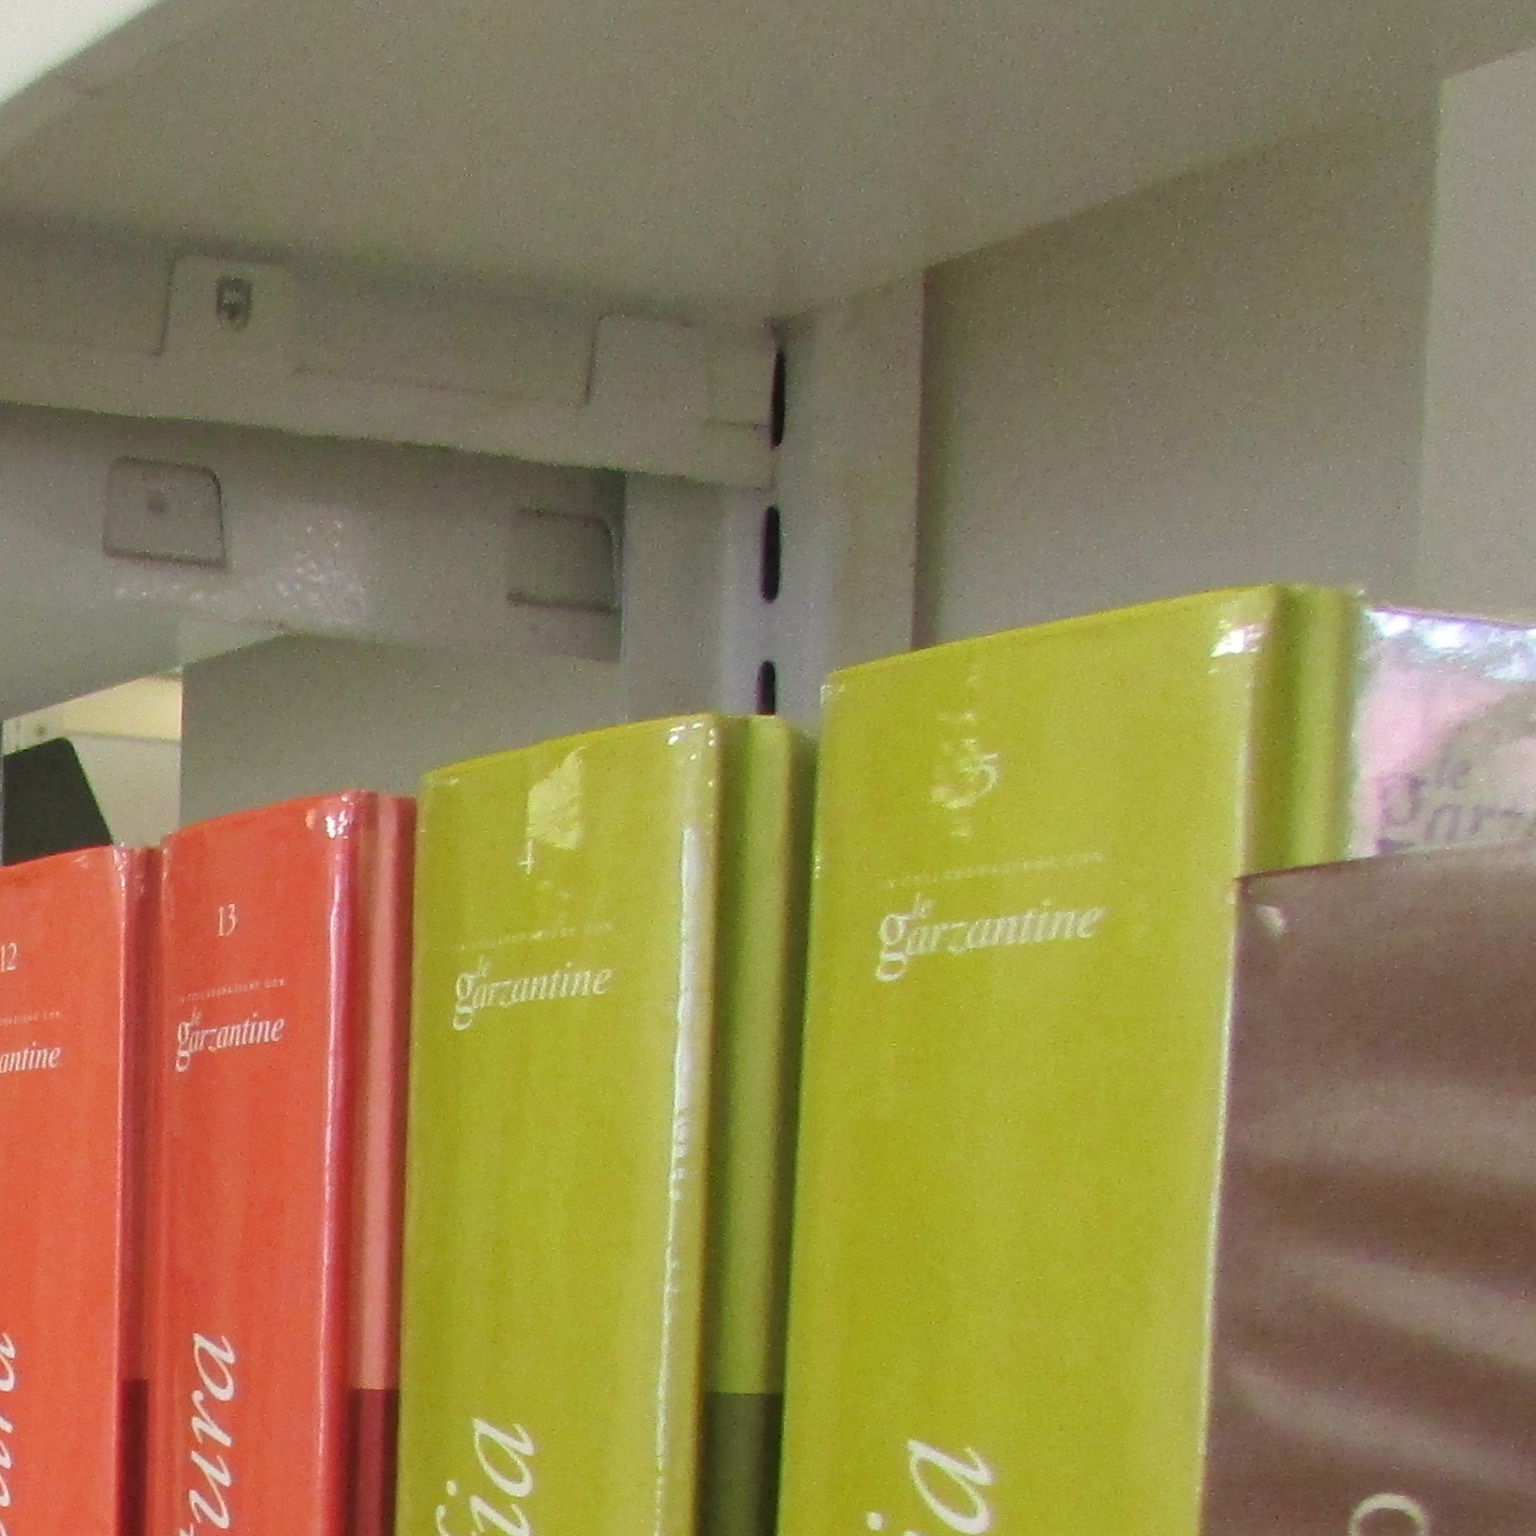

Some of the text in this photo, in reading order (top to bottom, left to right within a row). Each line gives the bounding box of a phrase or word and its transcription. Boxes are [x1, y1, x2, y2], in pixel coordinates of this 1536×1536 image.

[217, 905, 237, 938] 13
[876, 898, 1106, 981] garzantine
[0, 942, 18, 974] 12
[453, 961, 614, 1031] garzantine
[175, 1013, 285, 1072] garzantine
